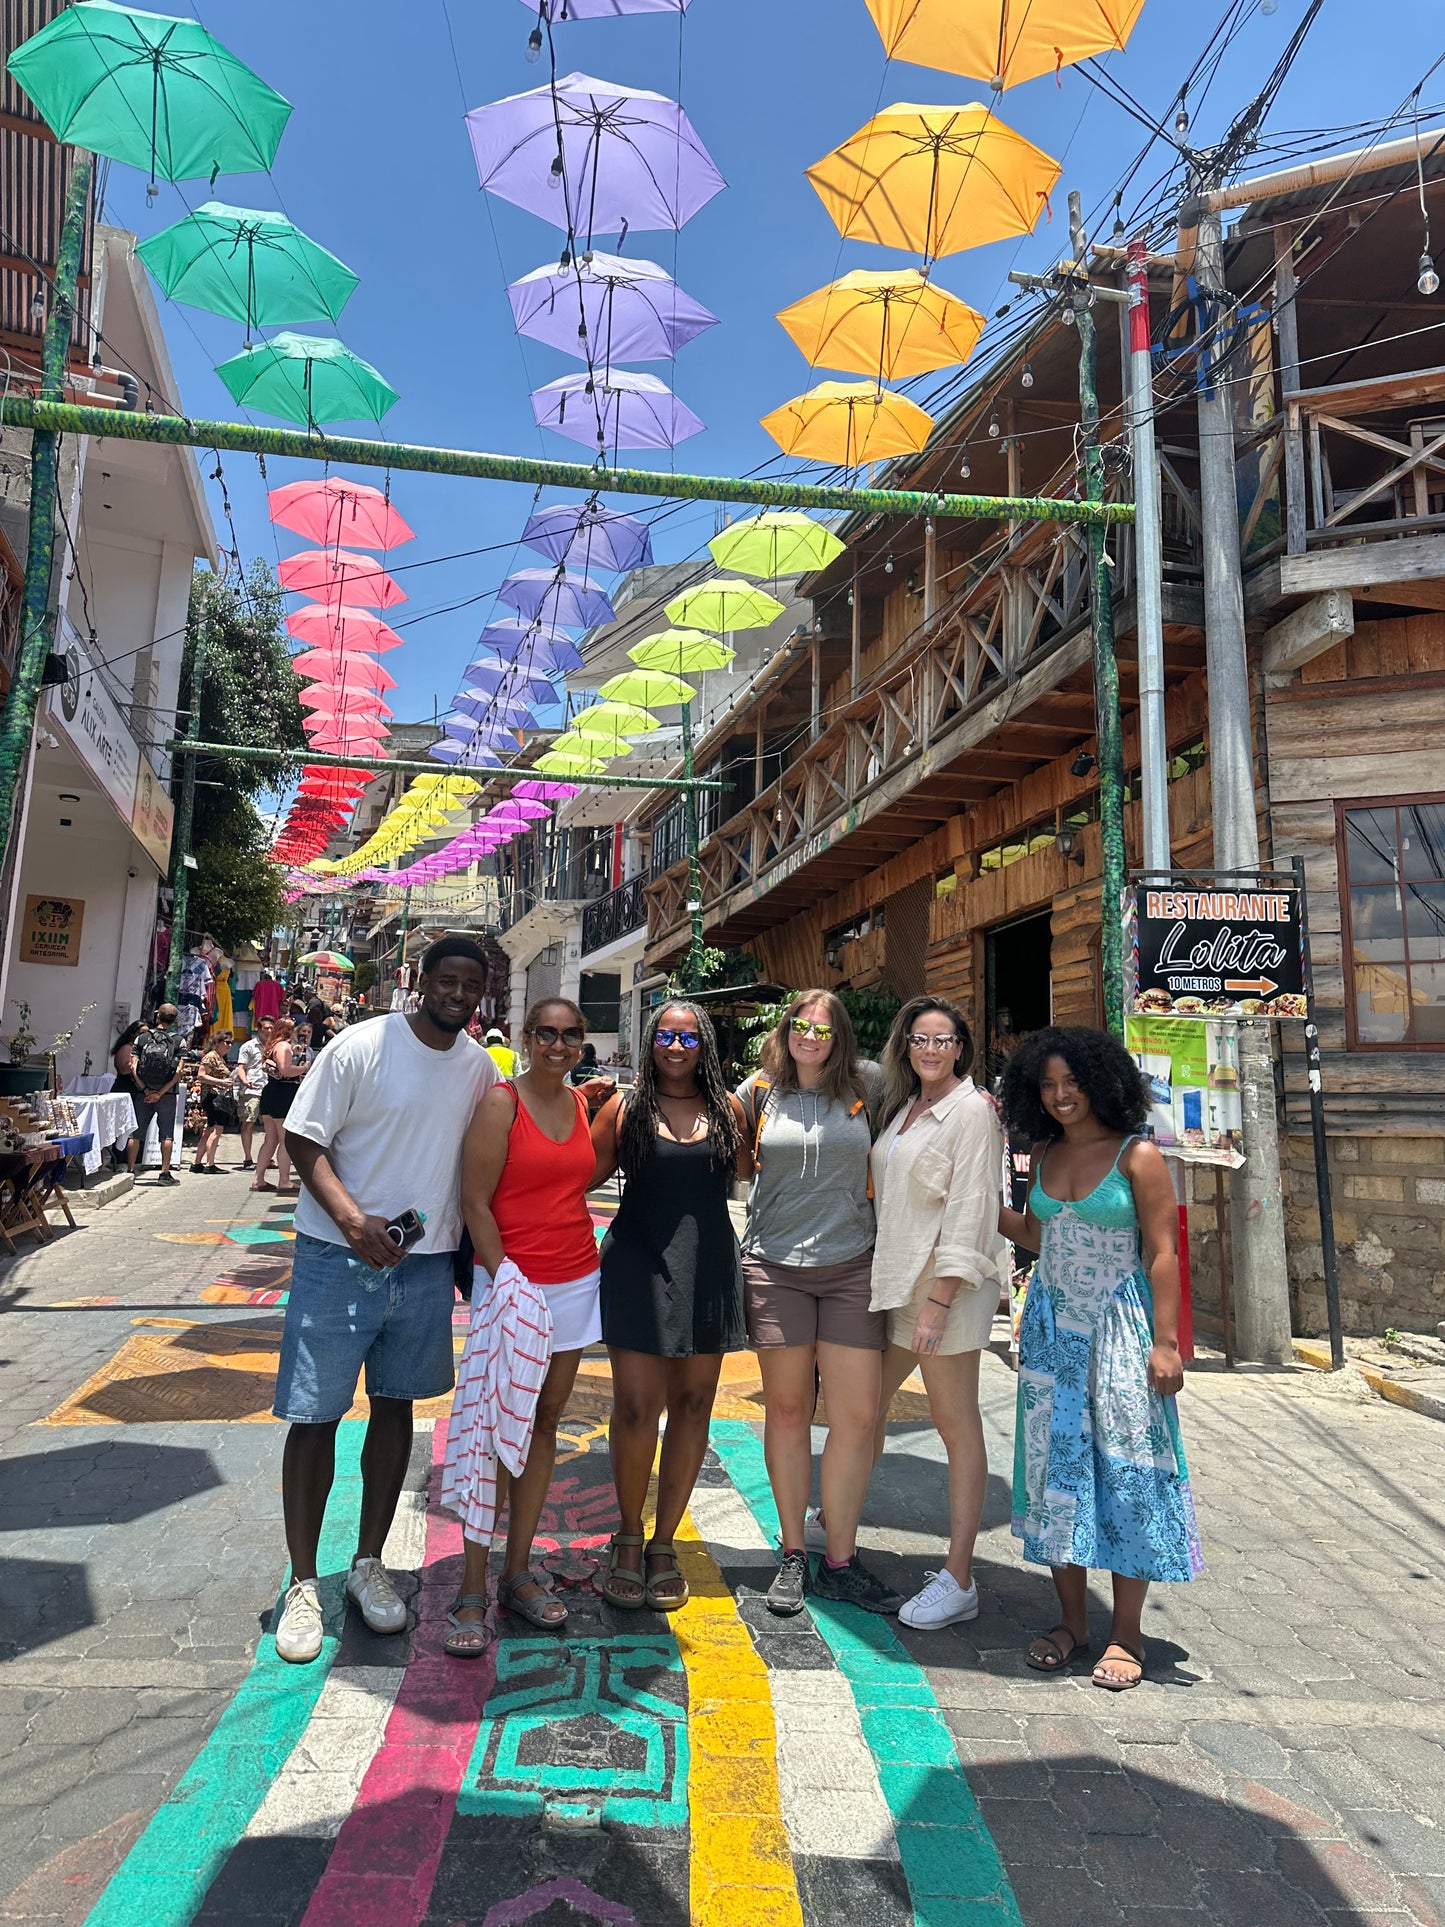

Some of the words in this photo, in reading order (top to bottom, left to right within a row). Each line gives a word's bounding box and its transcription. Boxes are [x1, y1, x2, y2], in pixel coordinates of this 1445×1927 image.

[81, 707, 97, 743] ALIX
[96, 732, 113, 767] ARTE
[789, 849, 801, 875] DEL
[1147, 892, 1291, 922] RESTAURANTE
[1154, 921, 1287, 974] Lolita
[1168, 977, 1180, 990] 10
[1182, 977, 1221, 991] METROS
